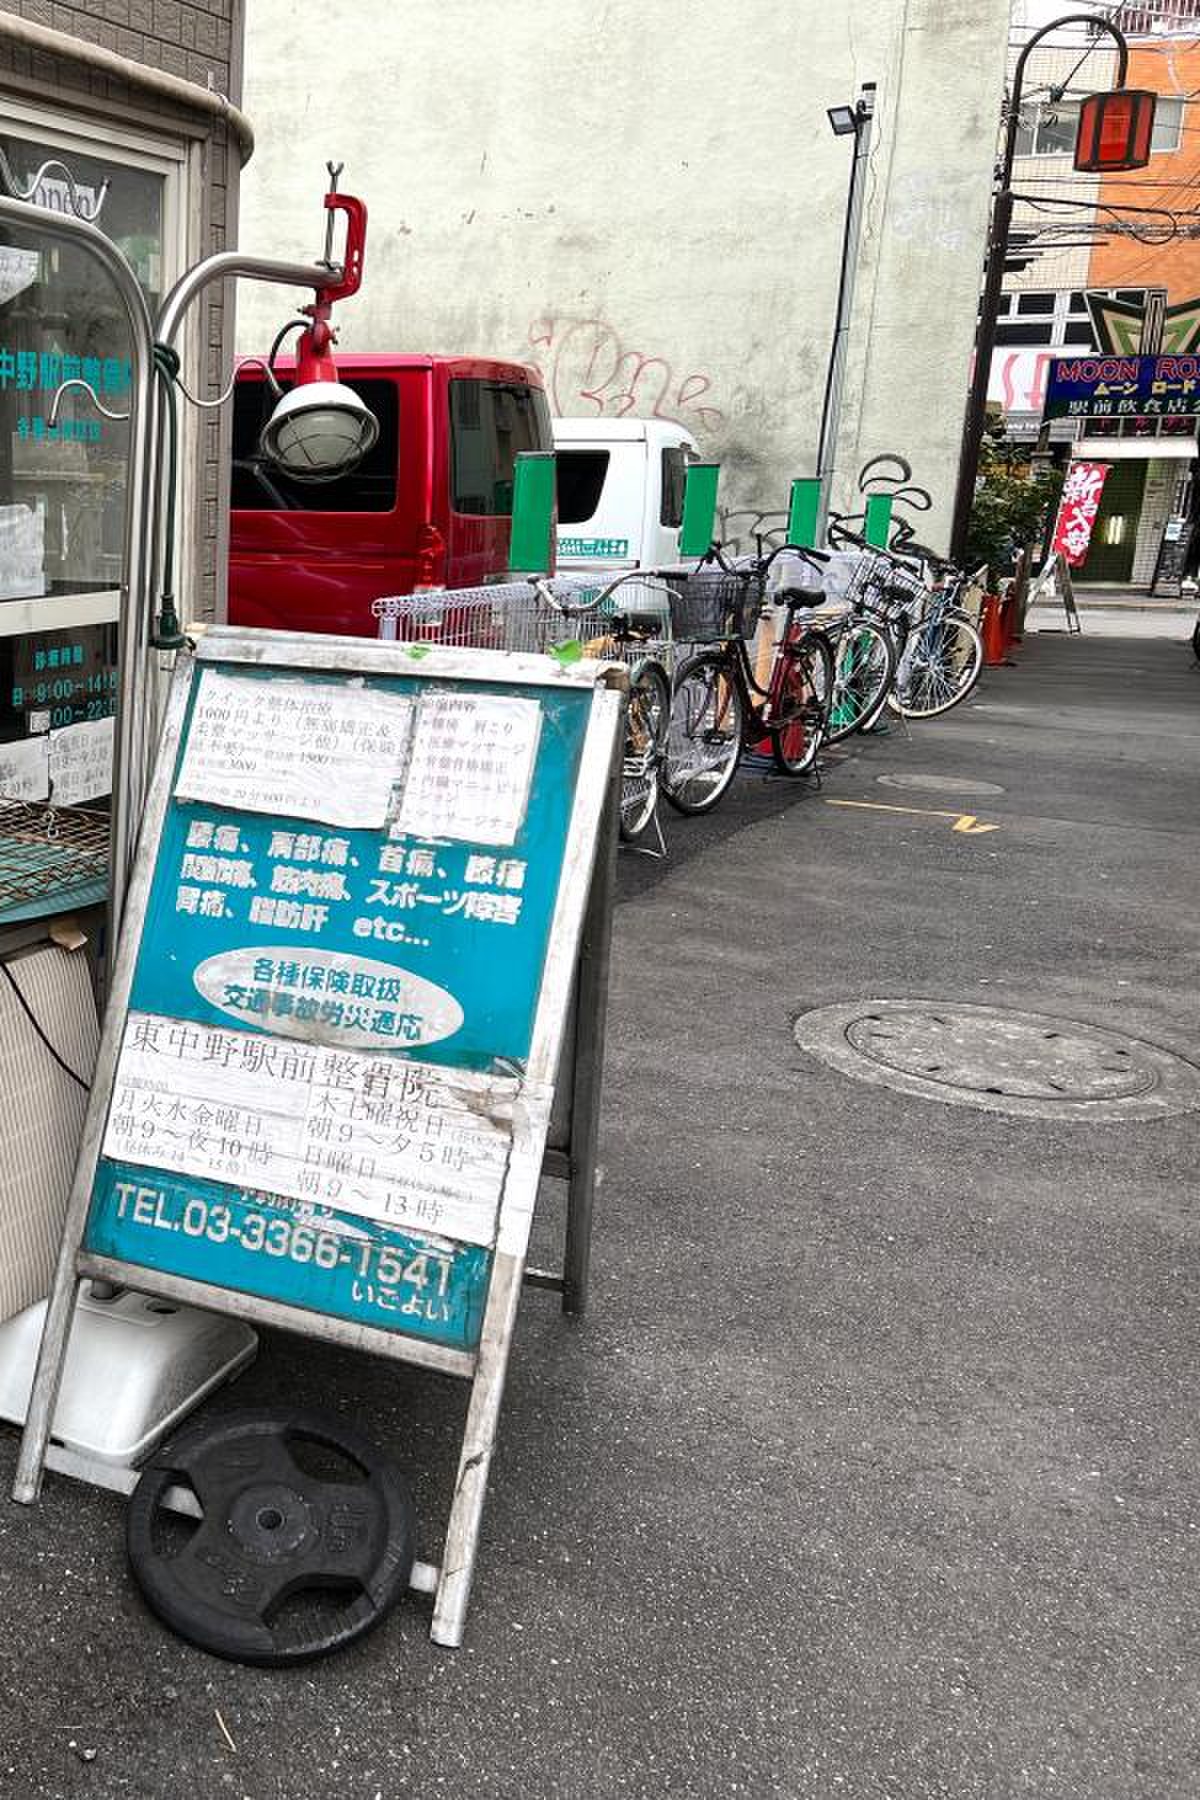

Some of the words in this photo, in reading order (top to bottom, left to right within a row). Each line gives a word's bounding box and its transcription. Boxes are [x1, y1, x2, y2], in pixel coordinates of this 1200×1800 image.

[1056, 359, 1140, 383] MOON
[1155, 357, 1200, 381] RO
[1093, 382, 1139, 396] ムーン
[1152, 380, 1197, 395] ロード
[253, 957, 402, 1004] 各種保険取扱
[132, 1018, 443, 1108] 東中野駅前整骨院
[116, 1088, 262, 1137] 月火水金曜日
[305, 1144, 376, 1180] 日曜日
